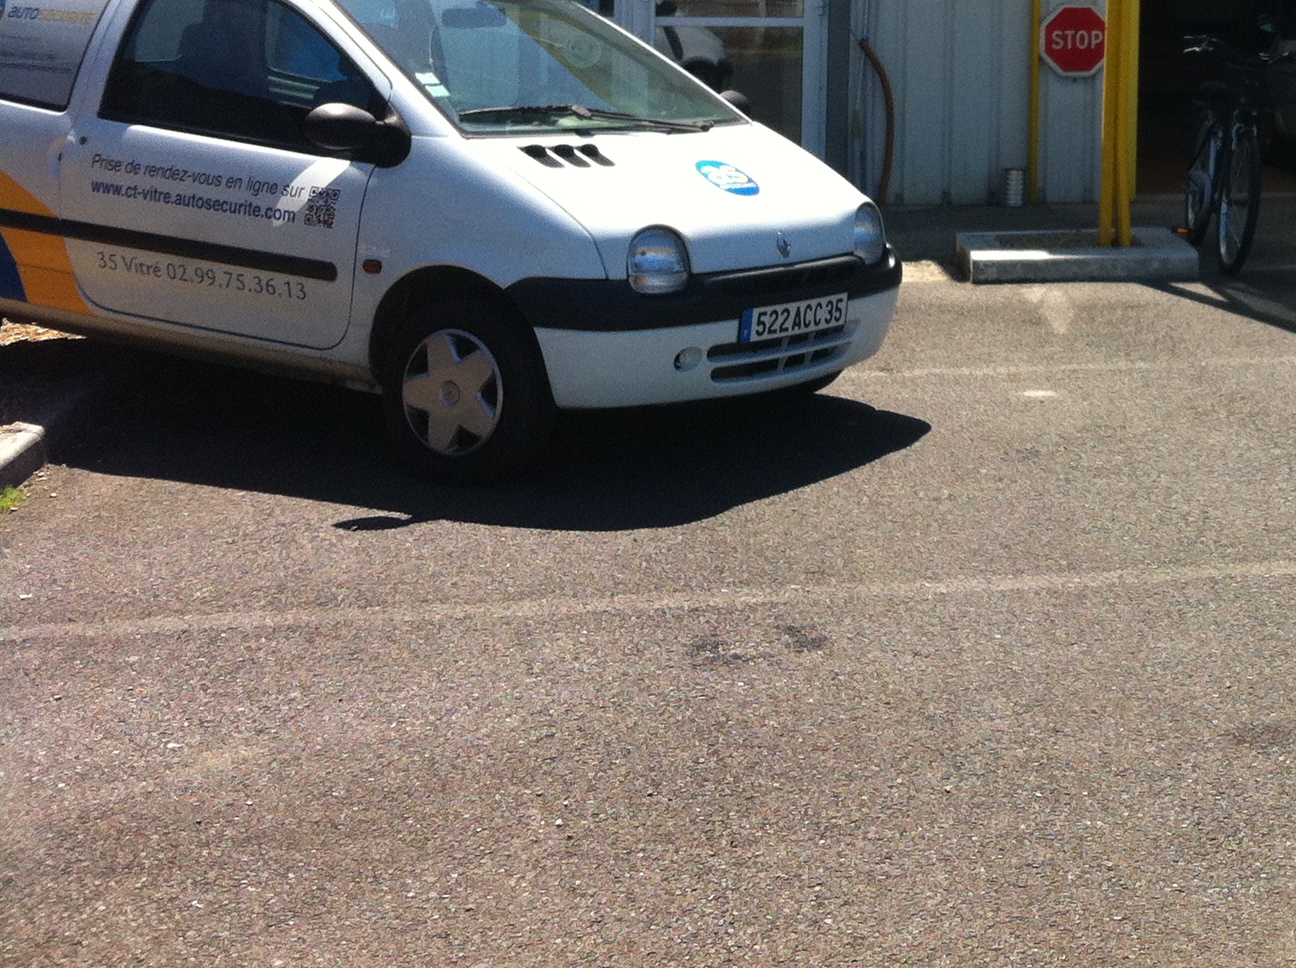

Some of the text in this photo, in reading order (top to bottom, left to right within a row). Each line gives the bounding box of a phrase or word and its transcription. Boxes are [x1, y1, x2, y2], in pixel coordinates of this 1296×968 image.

[1052, 30, 1103, 50] STOP
[91, 153, 304, 199] Prise de rendez-vous en ligne sur
[91, 180, 296, 223] www.ct-vitre.autosecurite.com
[97, 251, 307, 301] 35 Vitré 02.99.75.36.13
